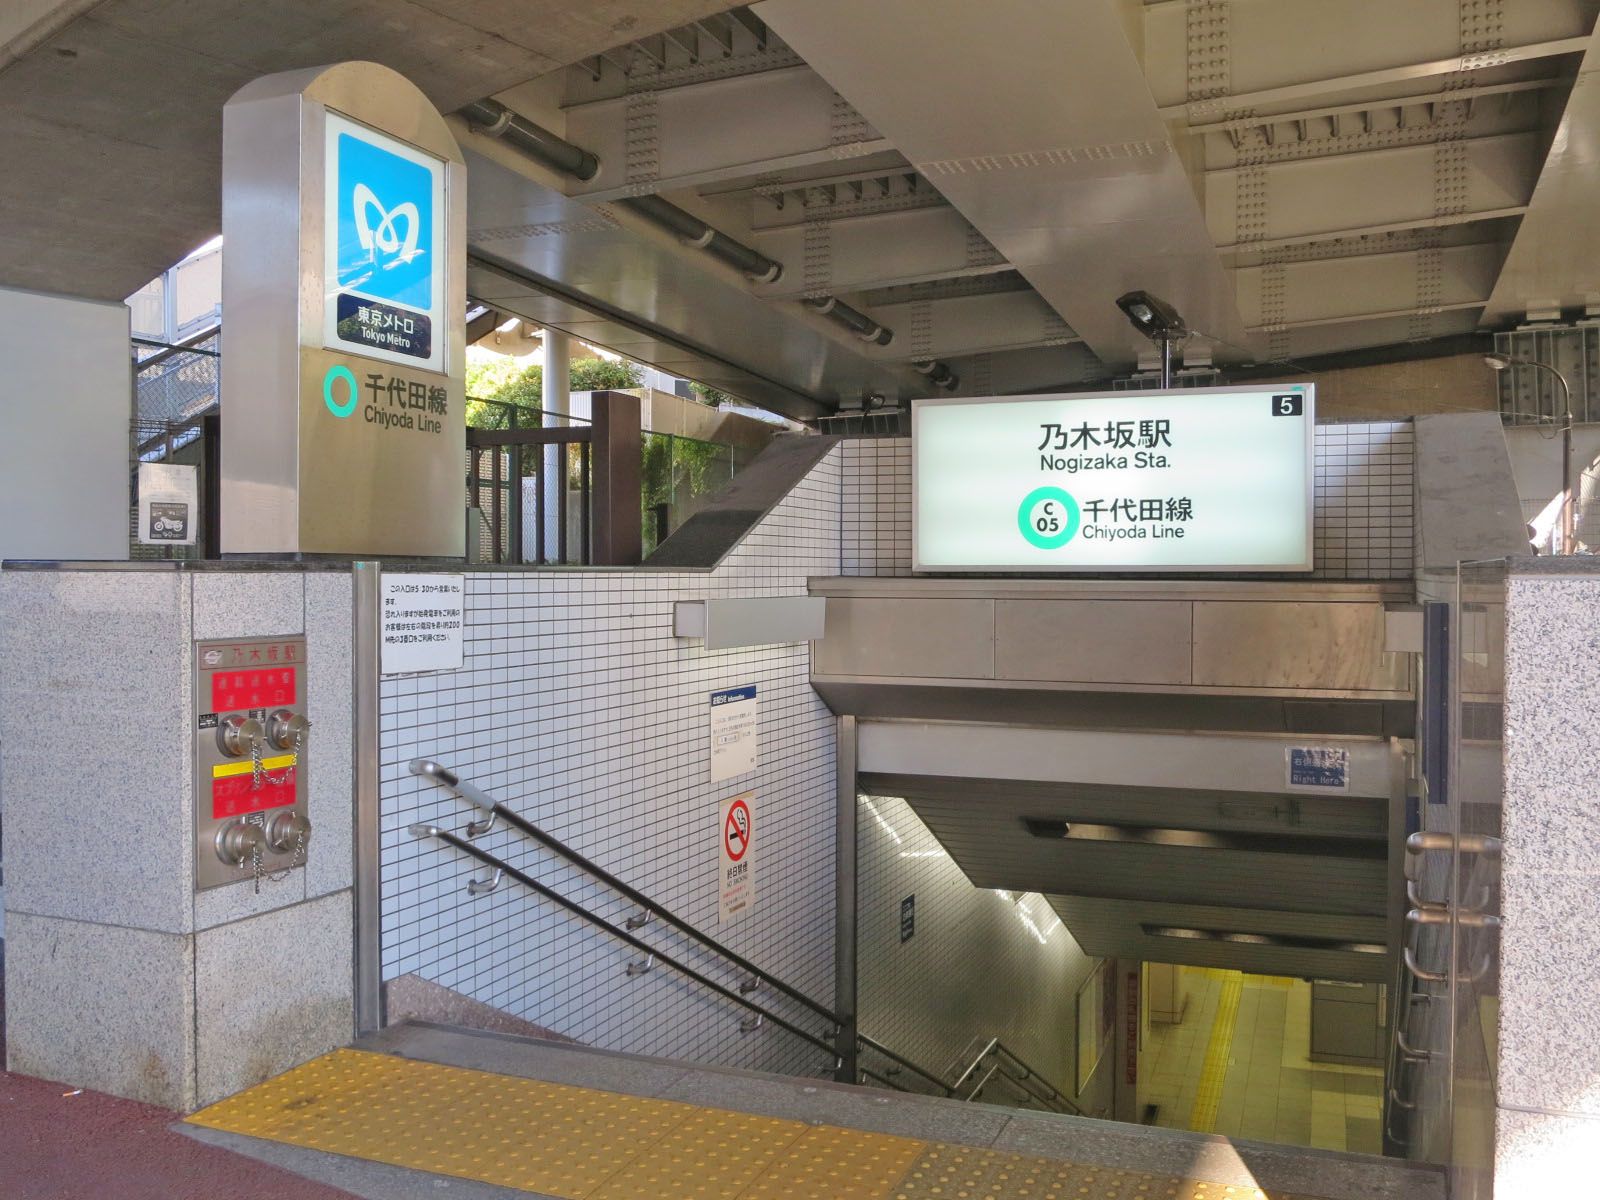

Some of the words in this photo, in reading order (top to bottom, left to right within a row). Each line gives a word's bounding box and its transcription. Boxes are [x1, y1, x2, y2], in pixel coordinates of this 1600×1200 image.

[358, 306, 413, 334] 東京メトロ
[361, 326, 385, 344] Tokyo
[387, 332, 411, 348] Metro
[365, 373, 447, 415] 千代田線
[1280, 397, 1293, 414] 5
[364, 405, 413, 430] Chiyoda
[418, 414, 441, 433] Line
[1038, 419, 1172, 451] 乃木坂駅
[1040, 453, 1128, 473] Nogizaka
[1134, 451, 1171, 468] Sta.
[1044, 502, 1053, 516] C
[1083, 497, 1193, 523] 千代田線
[1036, 517, 1059, 532] 05
[1083, 524, 1147, 541] Chiyoda
[1152, 524, 1184, 538] Line
[232, 645, 296, 662] 乃木坂駅
